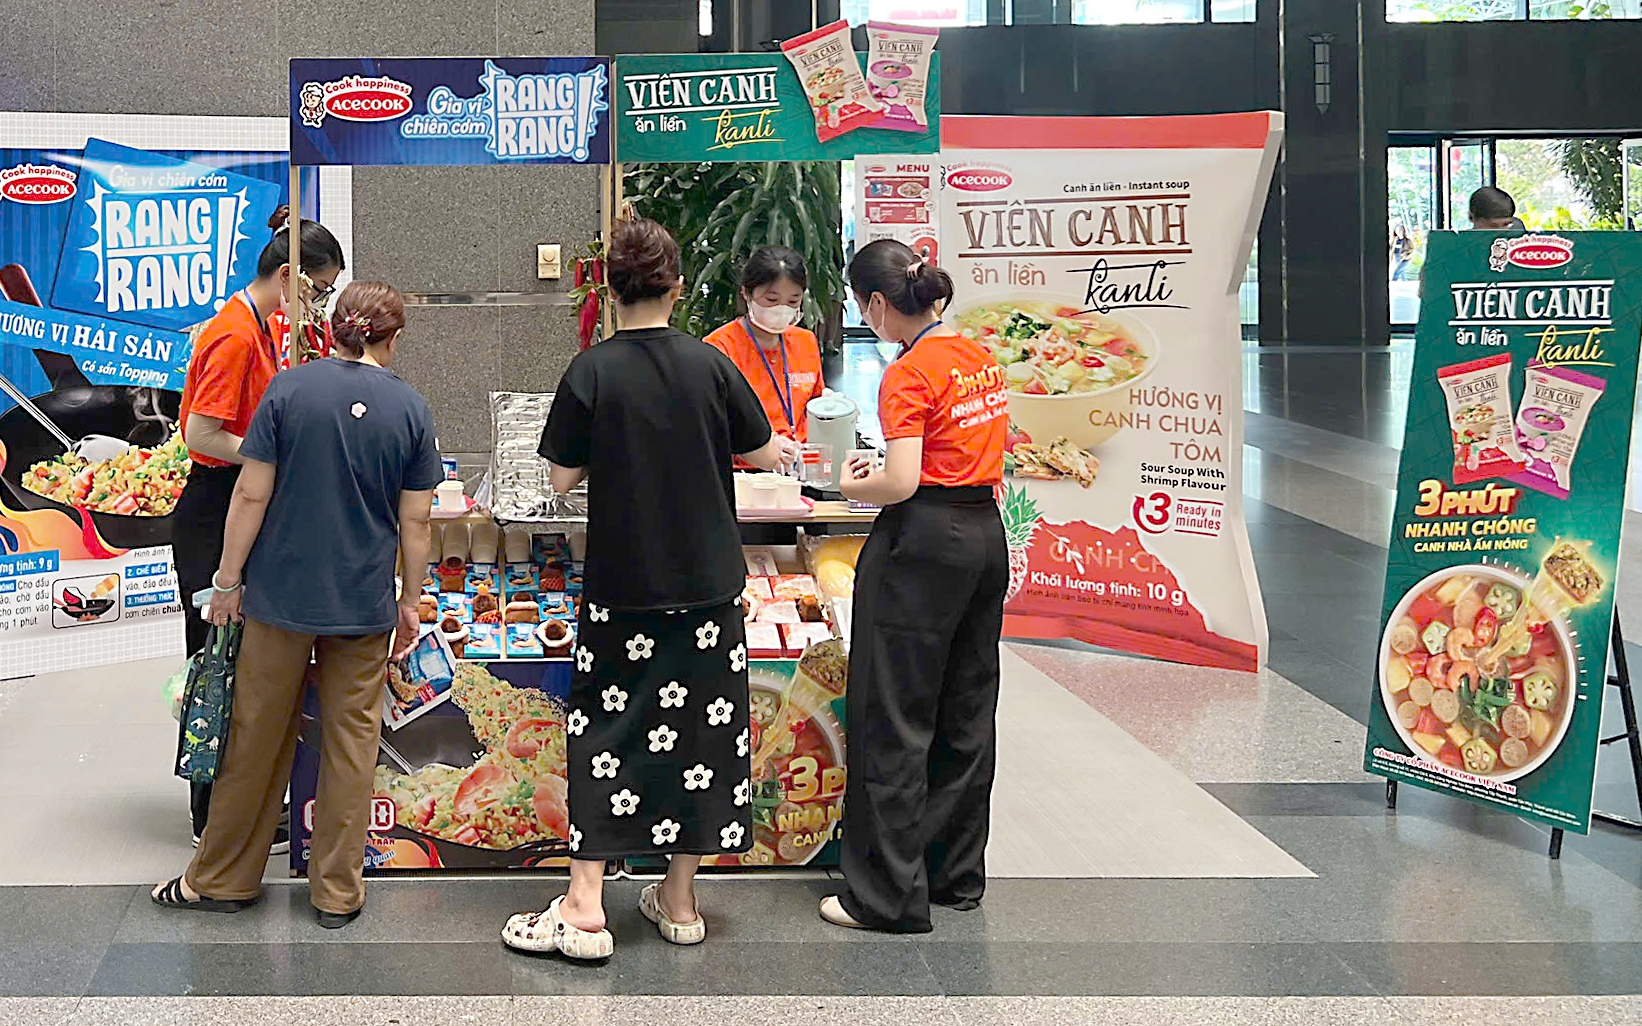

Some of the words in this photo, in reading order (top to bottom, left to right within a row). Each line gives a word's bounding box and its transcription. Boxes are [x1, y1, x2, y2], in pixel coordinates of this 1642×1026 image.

[325, 79, 353, 94] Cook
[355, 78, 409, 94] happiness
[497, 77, 574, 112] RANG
[624, 73, 692, 109] VIÊN
[699, 73, 778, 104] CANH
[430, 89, 463, 115] Gia
[468, 97, 483, 117] vị
[404, 116, 448, 135] chiên
[451, 117, 486, 135] cơm
[635, 115, 655, 133] ăn
[659, 114, 687, 132] liền
[2, 167, 26, 180] Cook
[28, 166, 74, 180] happiness
[109, 165, 136, 188] Gia
[158, 172, 196, 187] chiên
[198, 172, 228, 187] cơm
[896, 164, 930, 172] MENU
[946, 161, 967, 172] Cook
[1063, 184, 1087, 193] Canh
[1128, 181, 1164, 190] Instant
[1165, 181, 1190, 190] soup
[106, 196, 212, 248] RANG
[958, 199, 1056, 249] VIÊN
[1068, 203, 1190, 247] CANH
[1509, 237, 1529, 247] Cook
[971, 262, 999, 285] ăn
[1008, 260, 1046, 286] liền
[1451, 283, 1519, 319] VIÊN
[1525, 286, 1612, 319] CANH
[0, 312, 46, 339] ƯƠNG
[51, 322, 70, 347] VỊ
[72, 322, 118, 353] HẢI
[123, 332, 173, 363] SẢN
[1456, 327, 1476, 346] ăn
[1480, 326, 1508, 346] liền
[82, 359, 95, 372] Có
[120, 363, 169, 387] Topping
[1204, 394, 1222, 416] VỊ
[1089, 409, 1151, 430] CANH
[1158, 415, 1222, 436] CHUA
[1170, 439, 1222, 462] TÔM
[1141, 462, 1166, 473] Sour
[1168, 465, 1195, 477] Soup
[1197, 468, 1225, 479] With
[1141, 475, 1179, 488] Shrimp
[1181, 478, 1227, 491] Flavour
[1146, 492, 1172, 526] 3
[1176, 503, 1207, 518] Ready
[1211, 506, 1221, 517] in
[1176, 517, 1221, 531] minutes
[1405, 521, 1468, 538] NHANH
[1471, 515, 1536, 536] CHÓNG
[1414, 541, 1446, 553] CANH
[1447, 539, 1472, 551] NHÀ
[1473, 537, 1492, 551] ẤM
[1494, 537, 1528, 550] NÓNG
[38, 557, 44, 569] 9
[46, 559, 53, 571] g
[1031, 571, 1062, 587] Khối
[1066, 575, 1106, 595] lượng
[1110, 581, 1142, 598] tịnh:
[1147, 582, 1166, 600] 10
[1171, 590, 1184, 606] g
